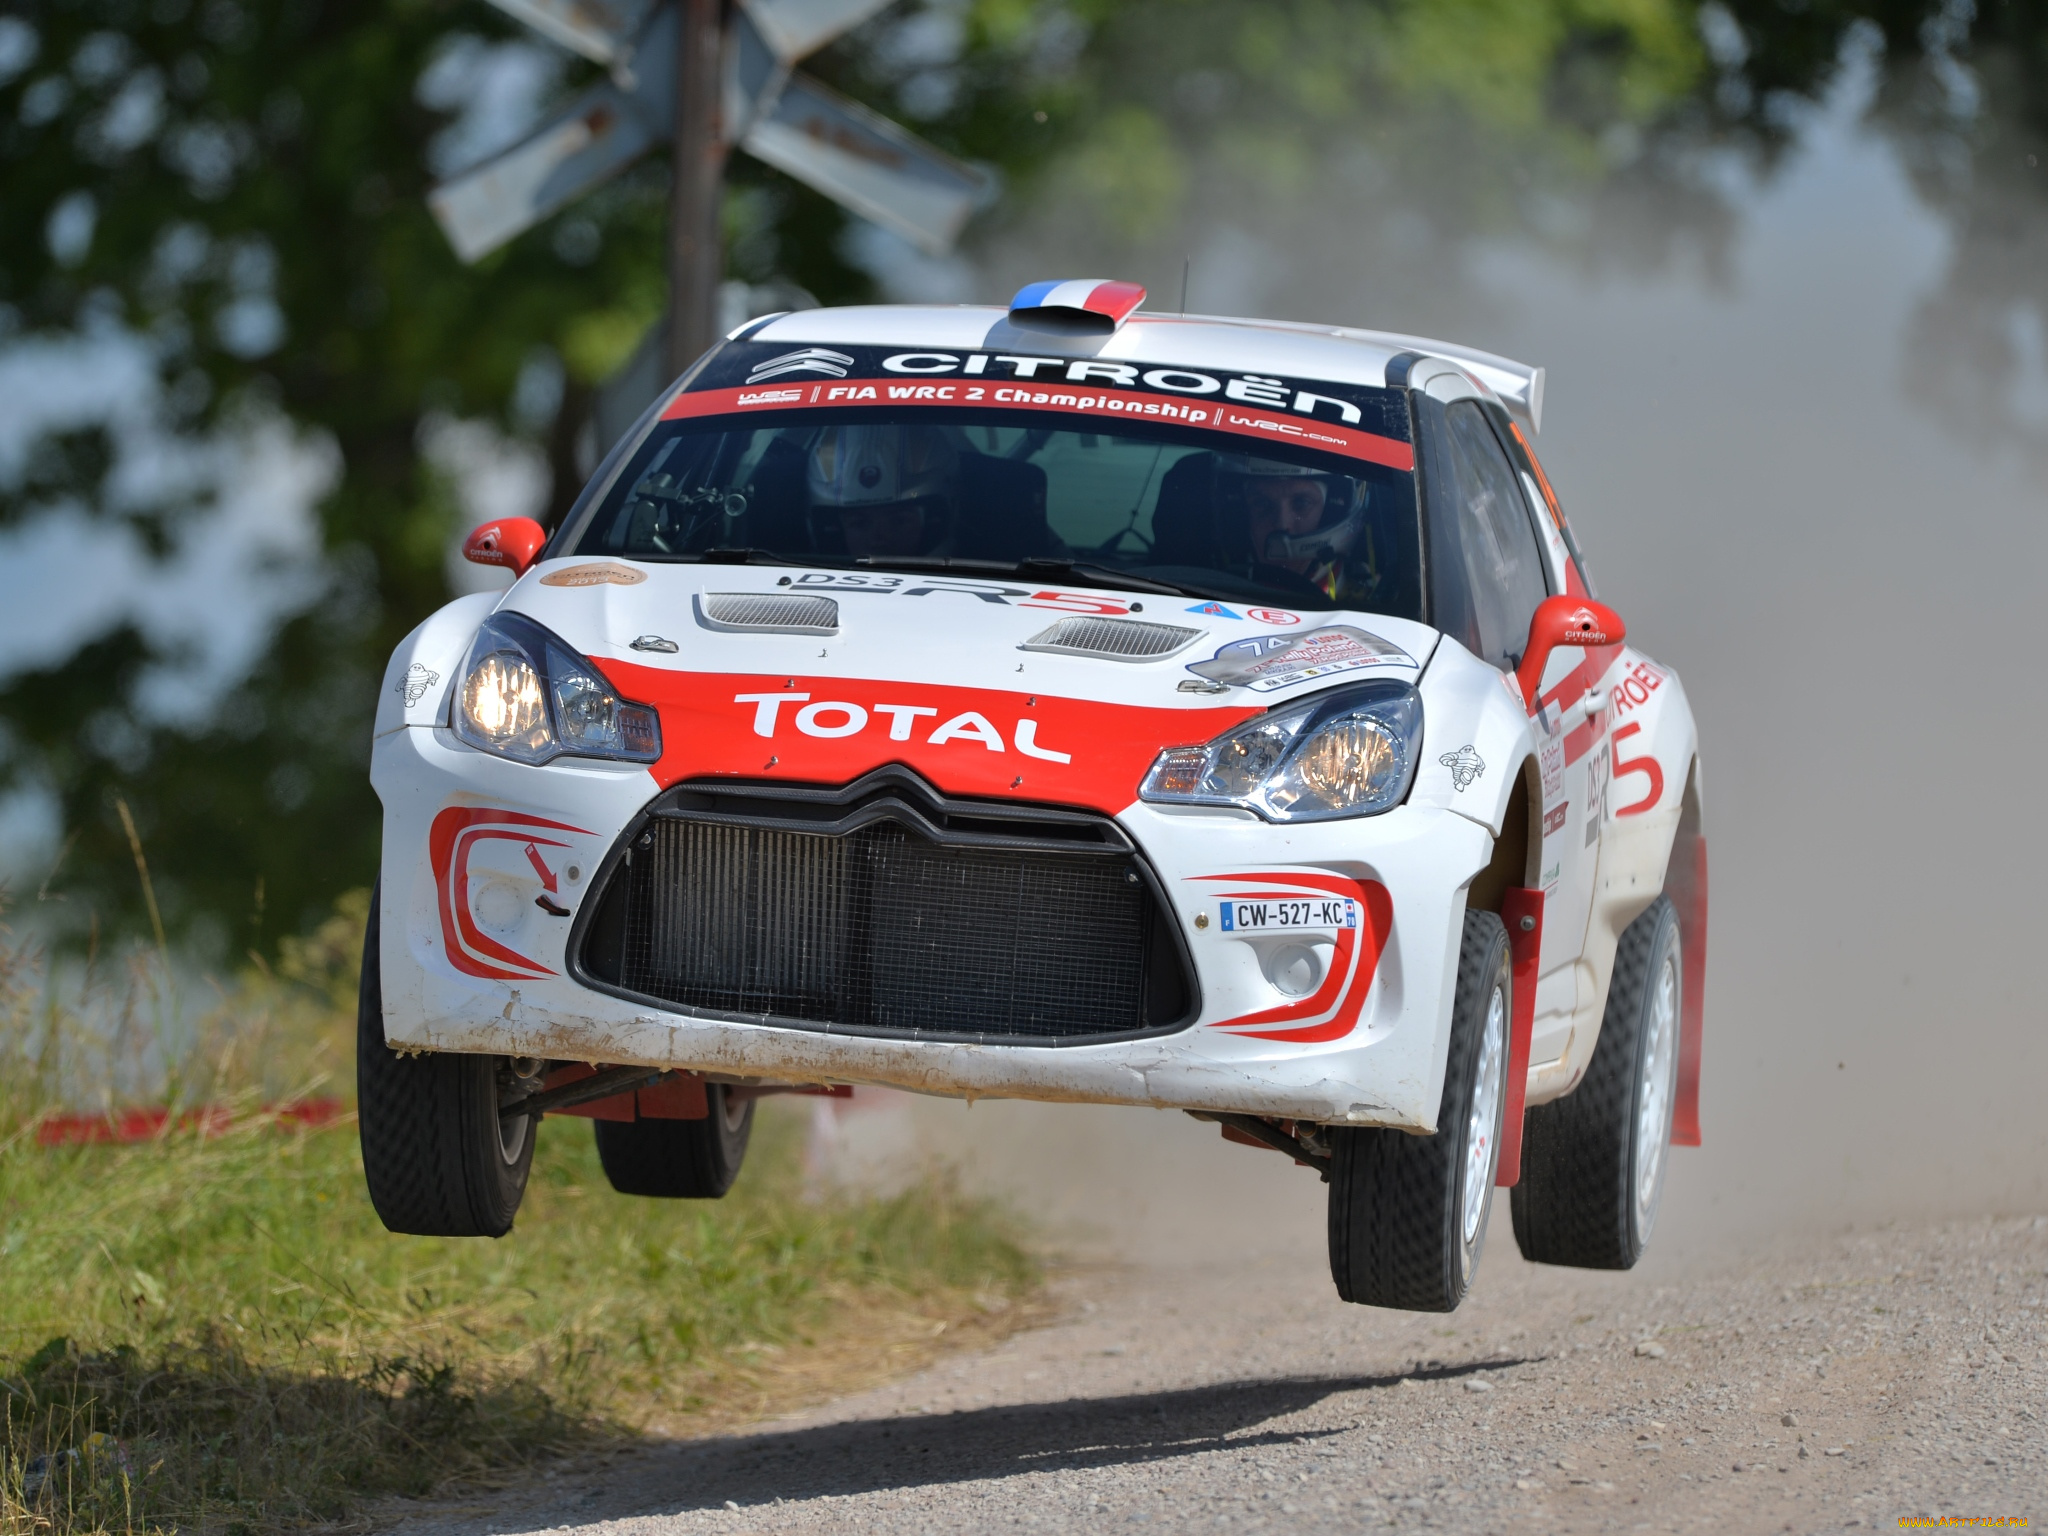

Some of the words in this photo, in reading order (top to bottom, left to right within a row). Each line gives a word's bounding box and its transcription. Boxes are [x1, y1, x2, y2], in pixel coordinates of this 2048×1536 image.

[827, 386, 877, 401] FIA
[887, 385, 957, 401] WRC
[964, 387, 984, 401] 2
[994, 388, 1208, 423] Championship
[882, 353, 1363, 425] CITROËN
[796, 573, 904, 588] DS3
[1238, 636, 1292, 658] 74
[733, 692, 1072, 765] TOTAL
[1238, 902, 1343, 927] CW-527-KC
